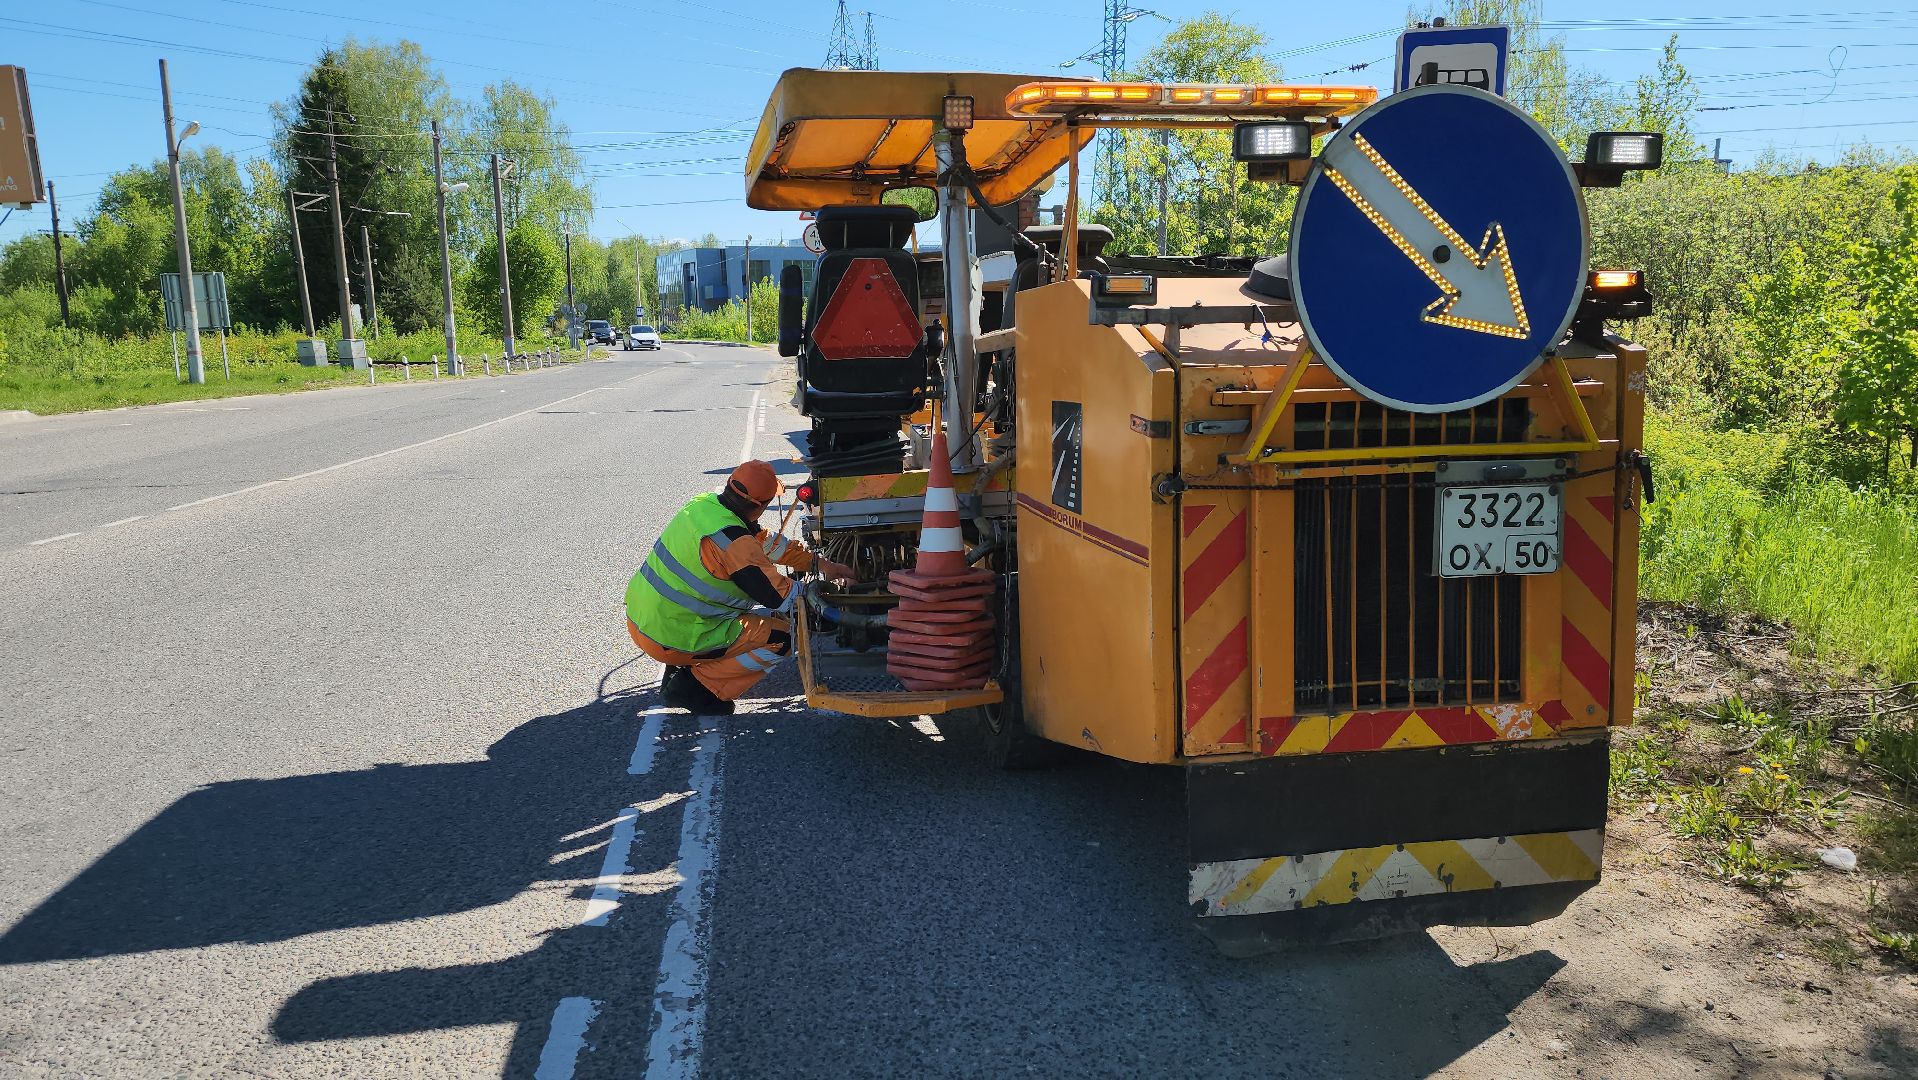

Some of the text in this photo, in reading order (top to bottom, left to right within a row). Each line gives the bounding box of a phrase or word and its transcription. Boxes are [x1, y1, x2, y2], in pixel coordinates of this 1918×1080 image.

[1052, 509, 1082, 530] BORUM
[1457, 492, 1545, 528] 3322
[1515, 541, 1549, 568] 50
